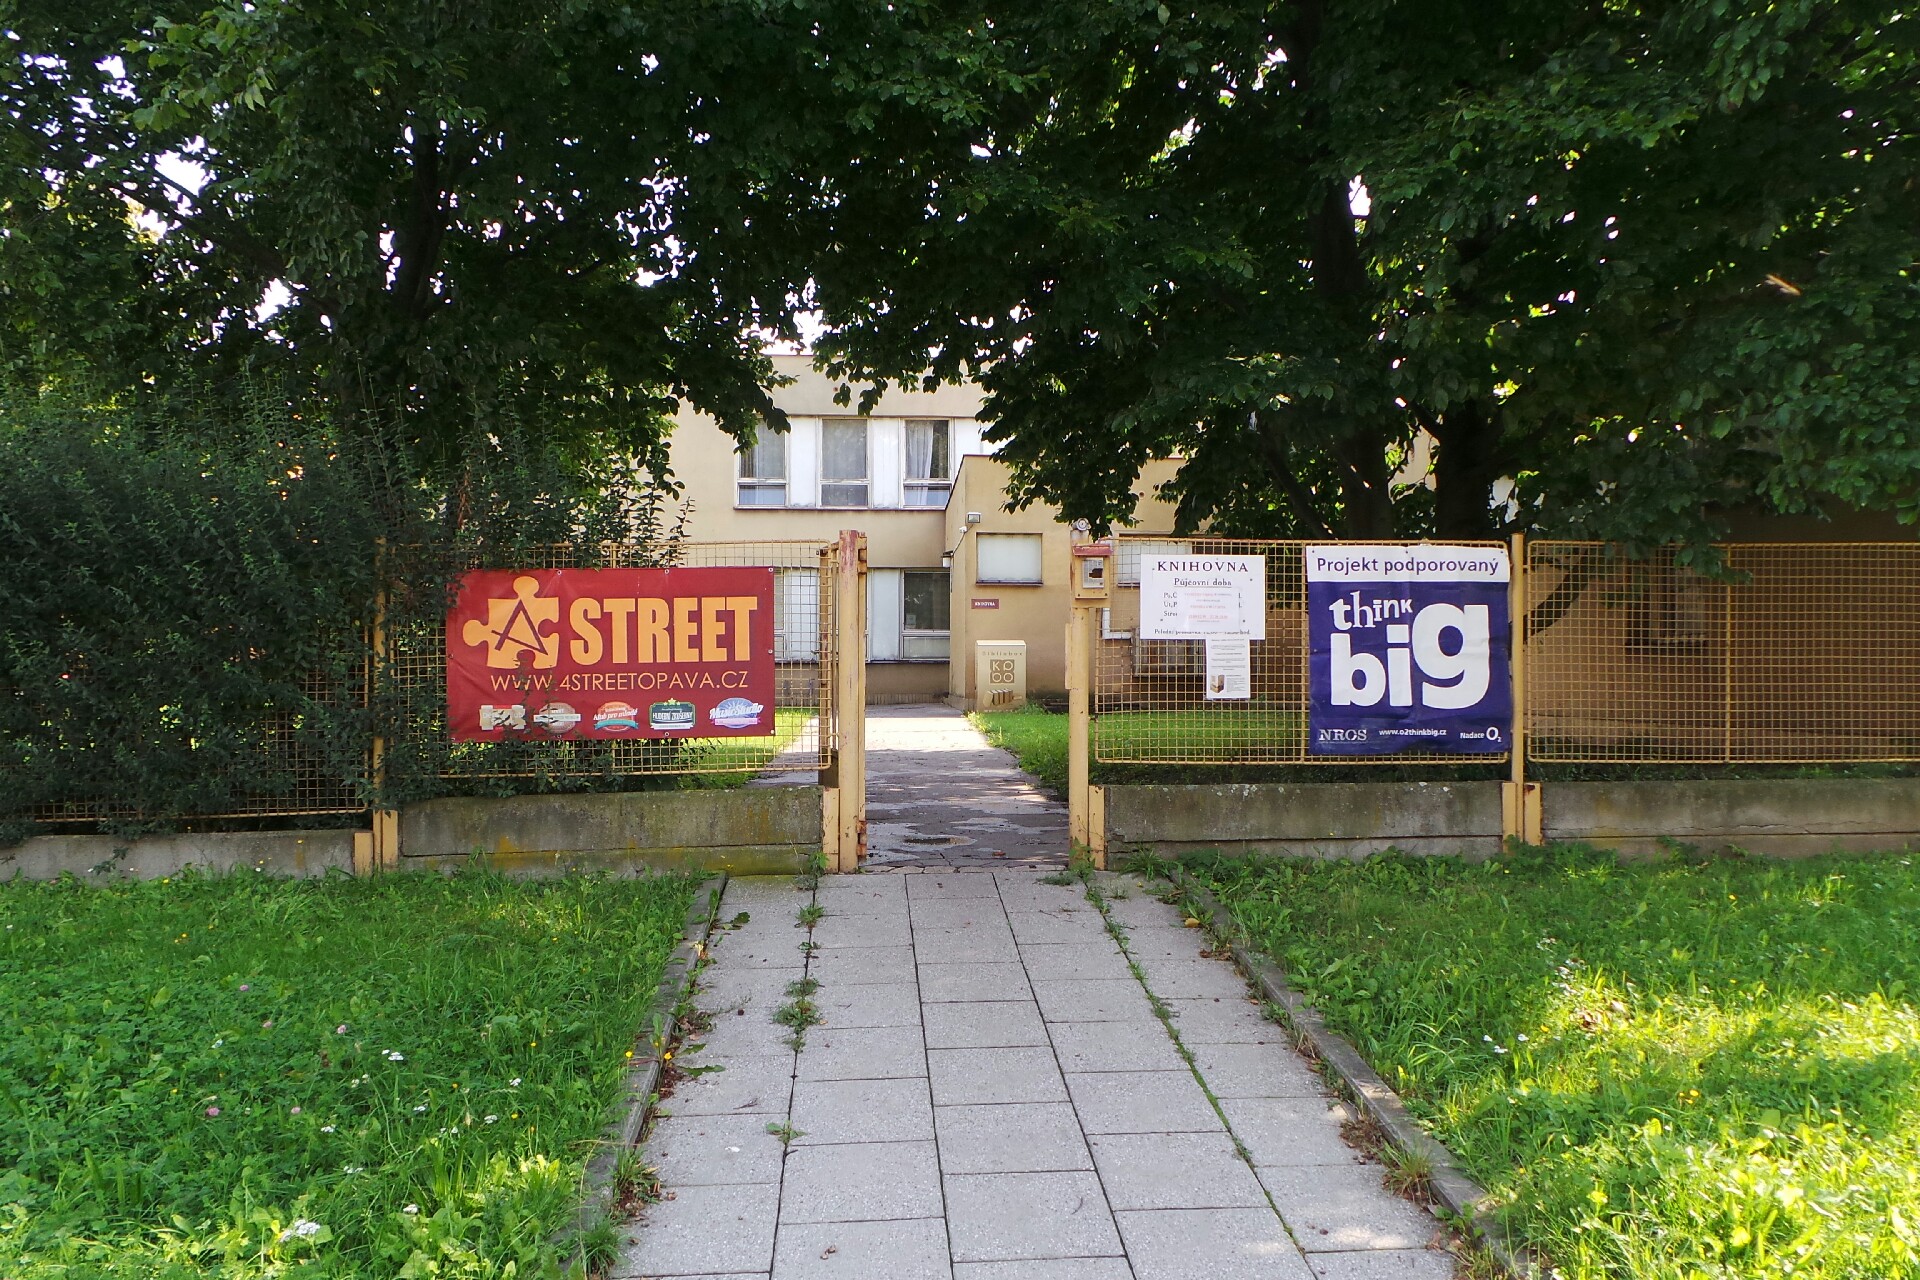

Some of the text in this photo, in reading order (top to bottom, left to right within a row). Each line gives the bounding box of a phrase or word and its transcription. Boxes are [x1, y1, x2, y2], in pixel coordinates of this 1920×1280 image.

[1157, 561, 1248, 572] KNIHOVNA
[1317, 557, 1499, 576] Projekt podporovaný
[1212, 577, 1232, 586] doba
[569, 596, 758, 666] STREET
[1330, 603, 1490, 710] big
[1318, 728, 1367, 741] NROS
[1379, 728, 1447, 737] www.o2thinkbig.cz
